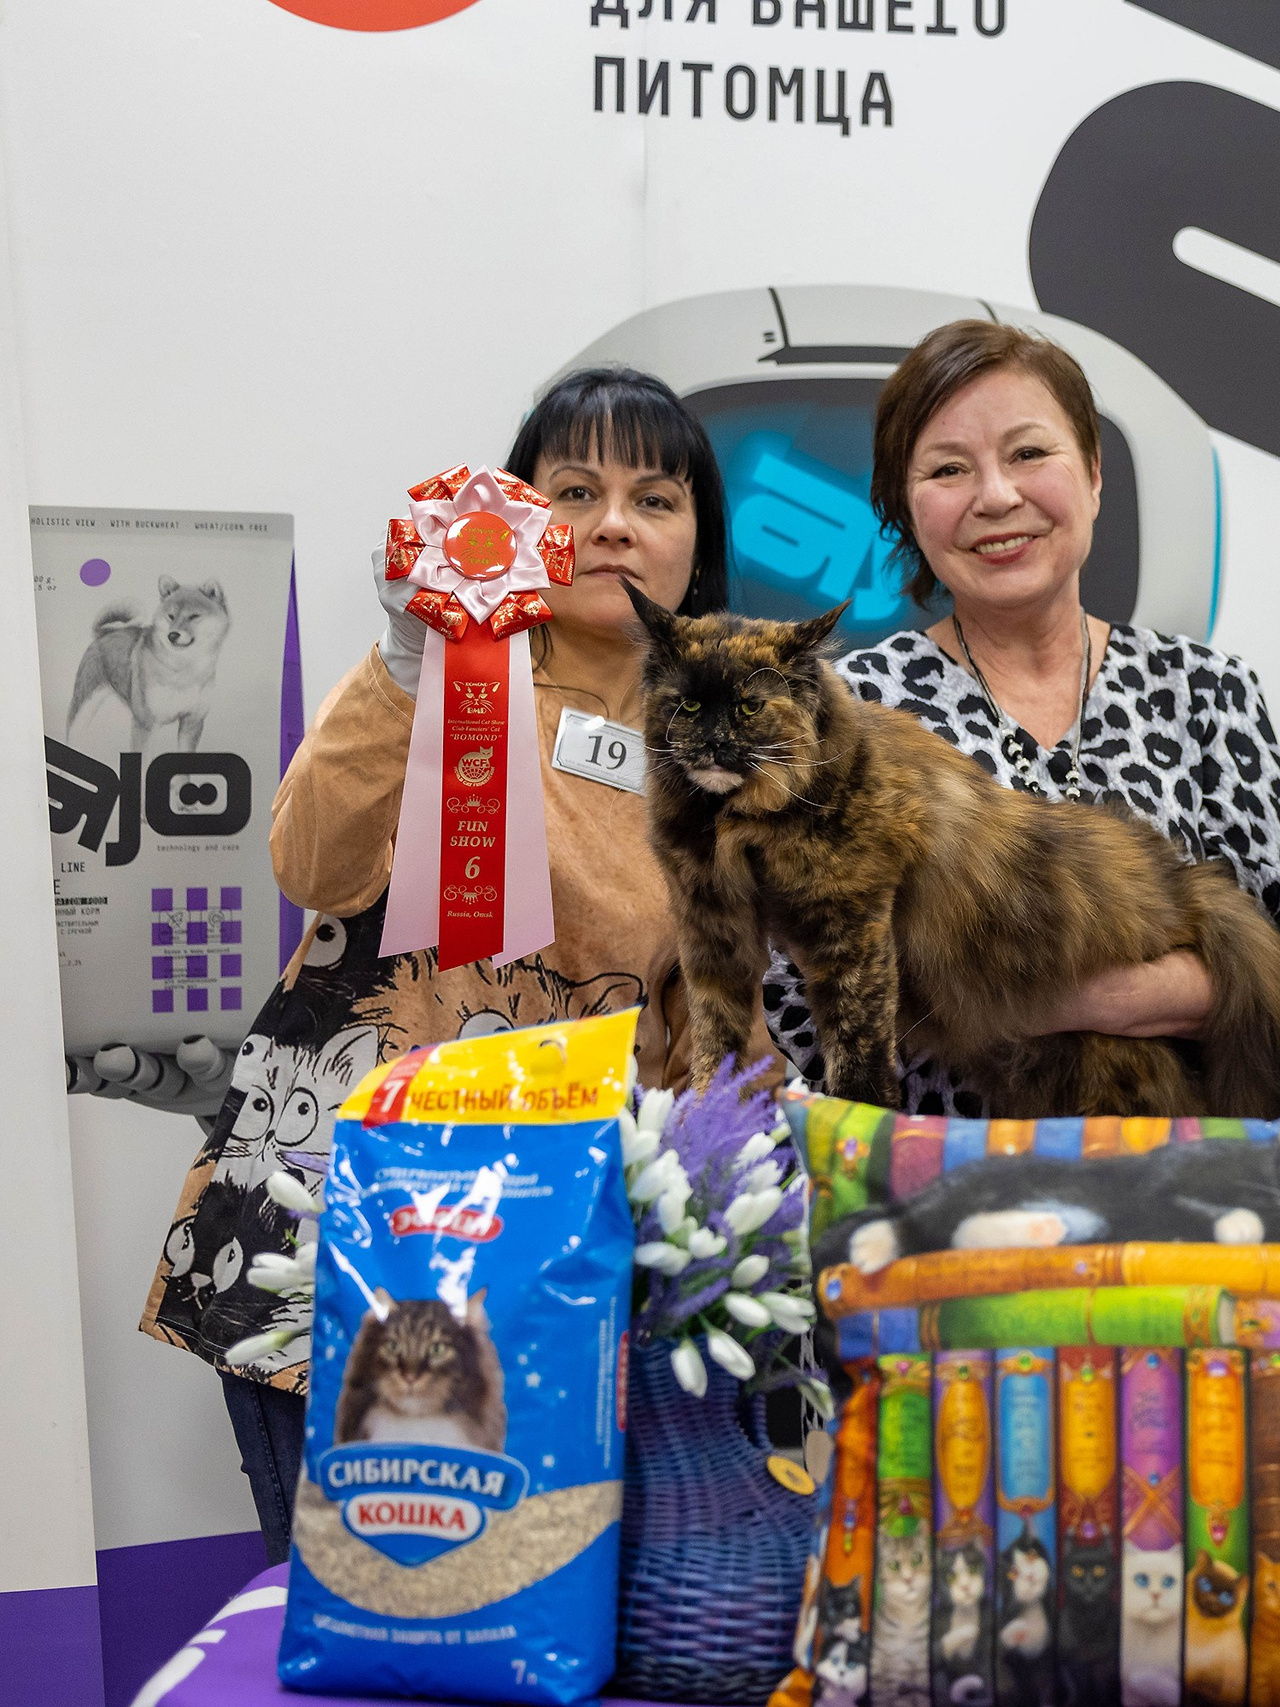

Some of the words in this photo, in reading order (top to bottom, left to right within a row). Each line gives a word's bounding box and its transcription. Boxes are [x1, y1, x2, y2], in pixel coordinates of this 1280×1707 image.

[594, 55, 894, 137] ПИТОМЦА
[461, 758, 489, 768] WCF
[585, 735, 627, 771] 19
[457, 820, 489, 832] FUN
[449, 835, 496, 848] SHOW
[61, 862, 86, 873] LINE
[464, 855, 481, 880] 6
[446, 910, 472, 918] Russia,
[473, 910, 494, 918] Omsk
[410, 1083, 515, 1114] ЧЕСТНЫЙ
[518, 1080, 600, 1110] ОБЪЁМ
[327, 1457, 506, 1498] СИБИРСКАЯ
[358, 1502, 467, 1532] КОШКА
